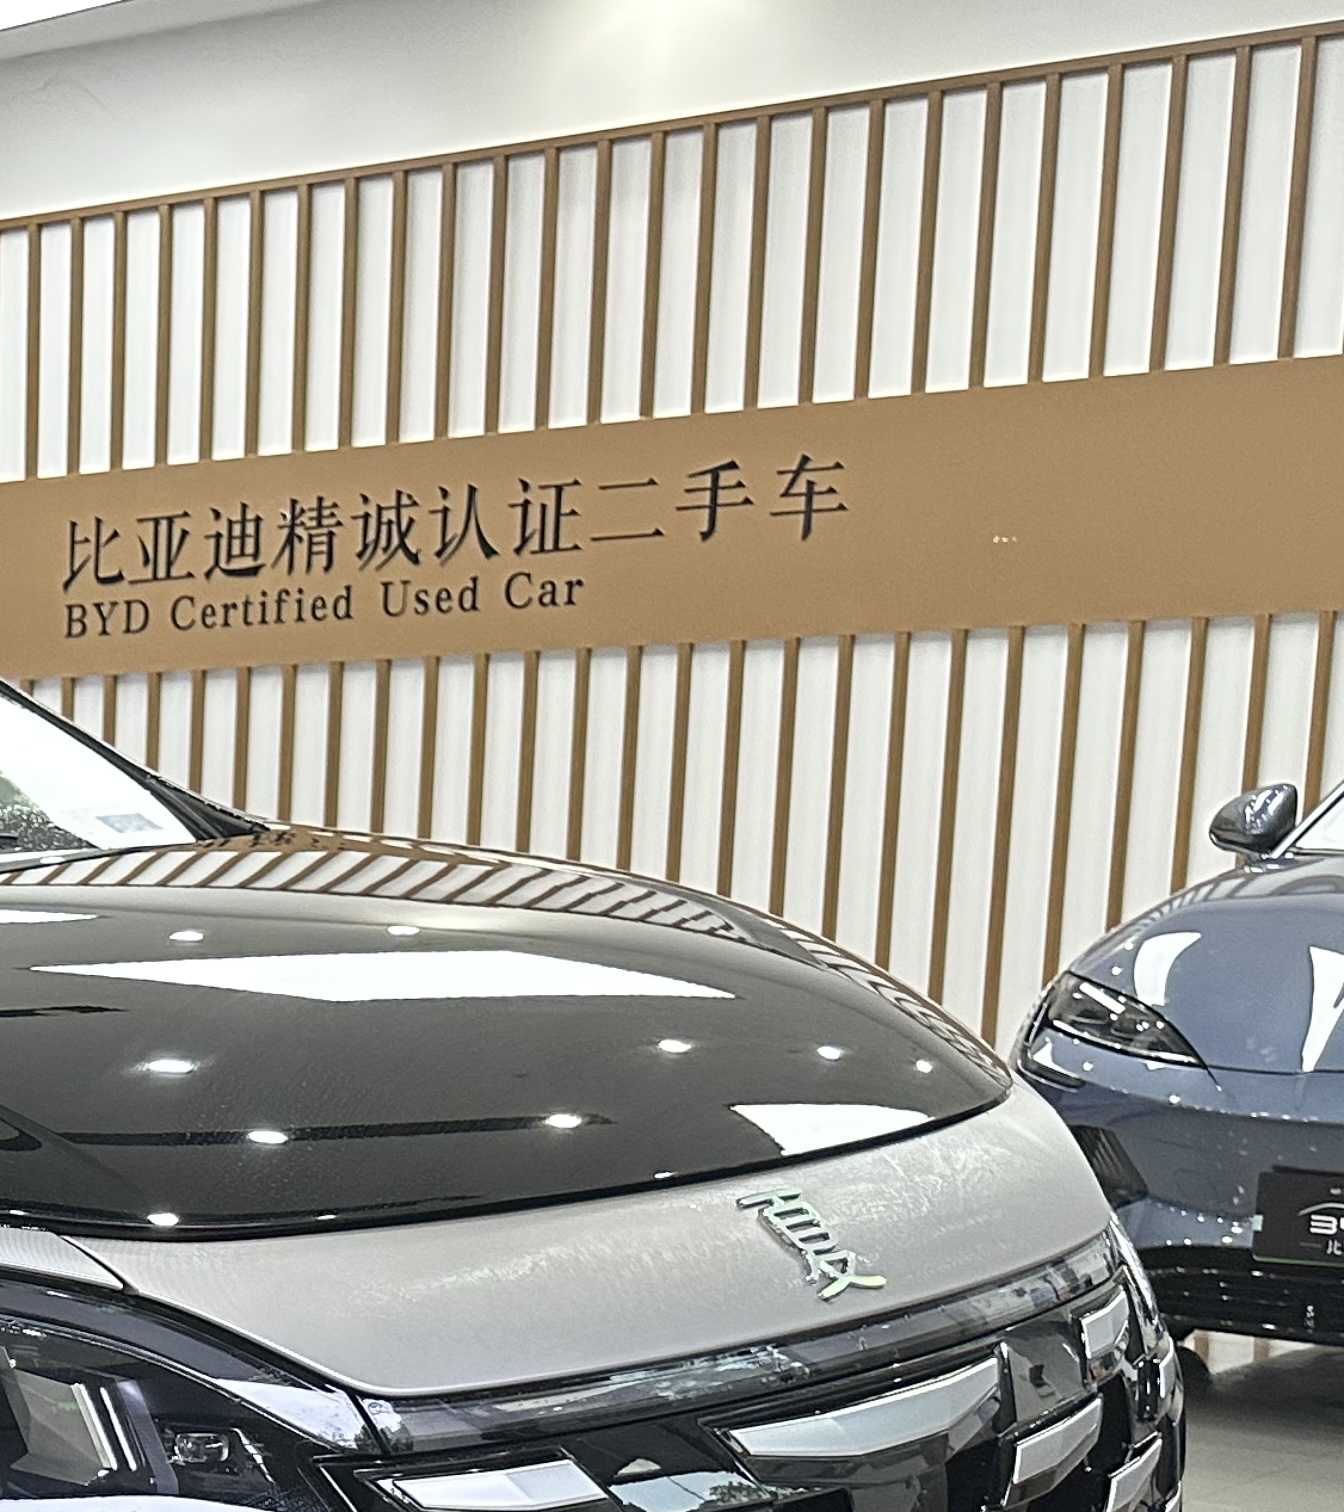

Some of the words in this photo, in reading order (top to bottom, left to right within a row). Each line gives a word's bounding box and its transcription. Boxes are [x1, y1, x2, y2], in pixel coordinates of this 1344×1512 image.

[61, 453, 850, 594] 比亚迪精诚认证二手车
[64, 598, 152, 640] BYD
[169, 583, 354, 633] Certified
[379, 573, 480, 619] Used
[503, 570, 585, 611] Car
